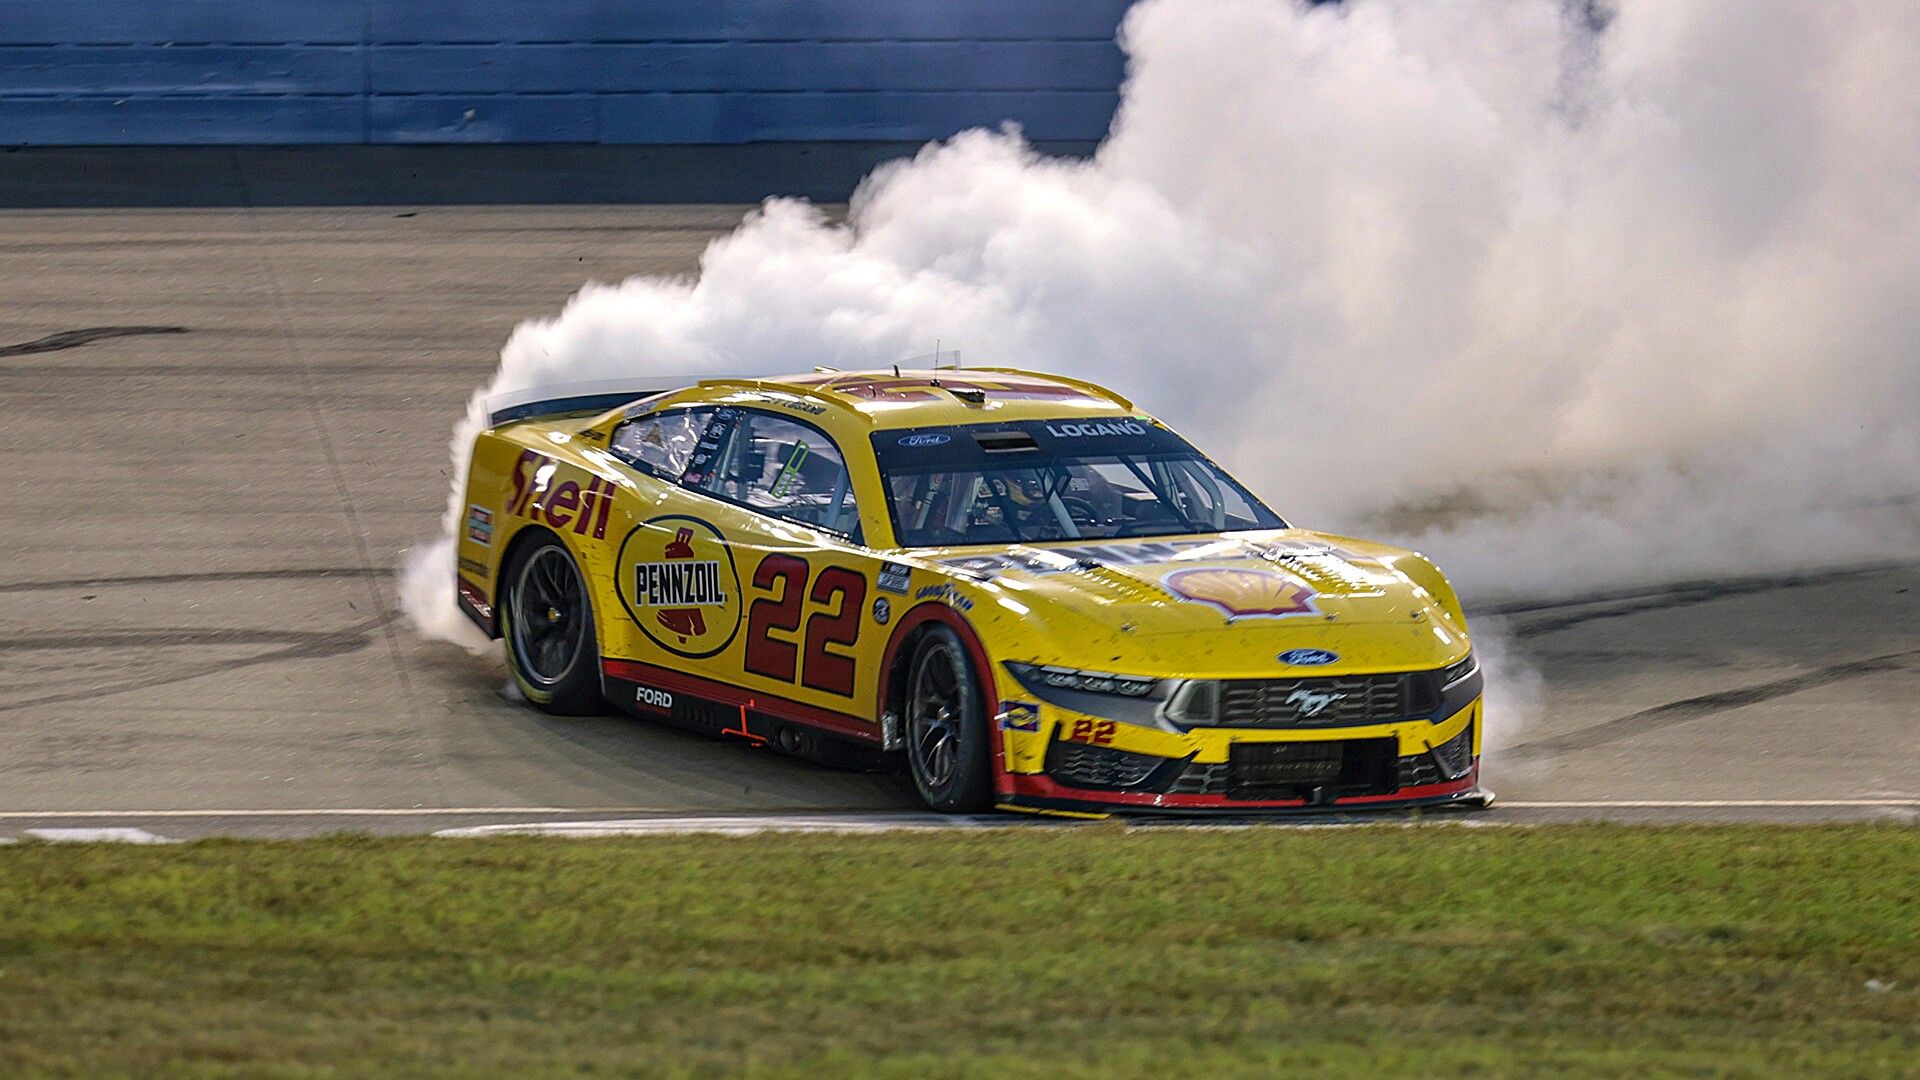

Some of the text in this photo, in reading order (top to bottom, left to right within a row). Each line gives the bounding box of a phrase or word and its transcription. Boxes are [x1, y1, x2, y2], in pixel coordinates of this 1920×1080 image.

[908, 434, 942, 445] Ford
[1047, 423, 1146, 438] LOGANO
[506, 448, 617, 540] Shell
[635, 561, 725, 607] PENNZOIL
[744, 552, 868, 699] 22
[636, 686, 673, 708] FORD
[1072, 719, 1117, 744] 22
